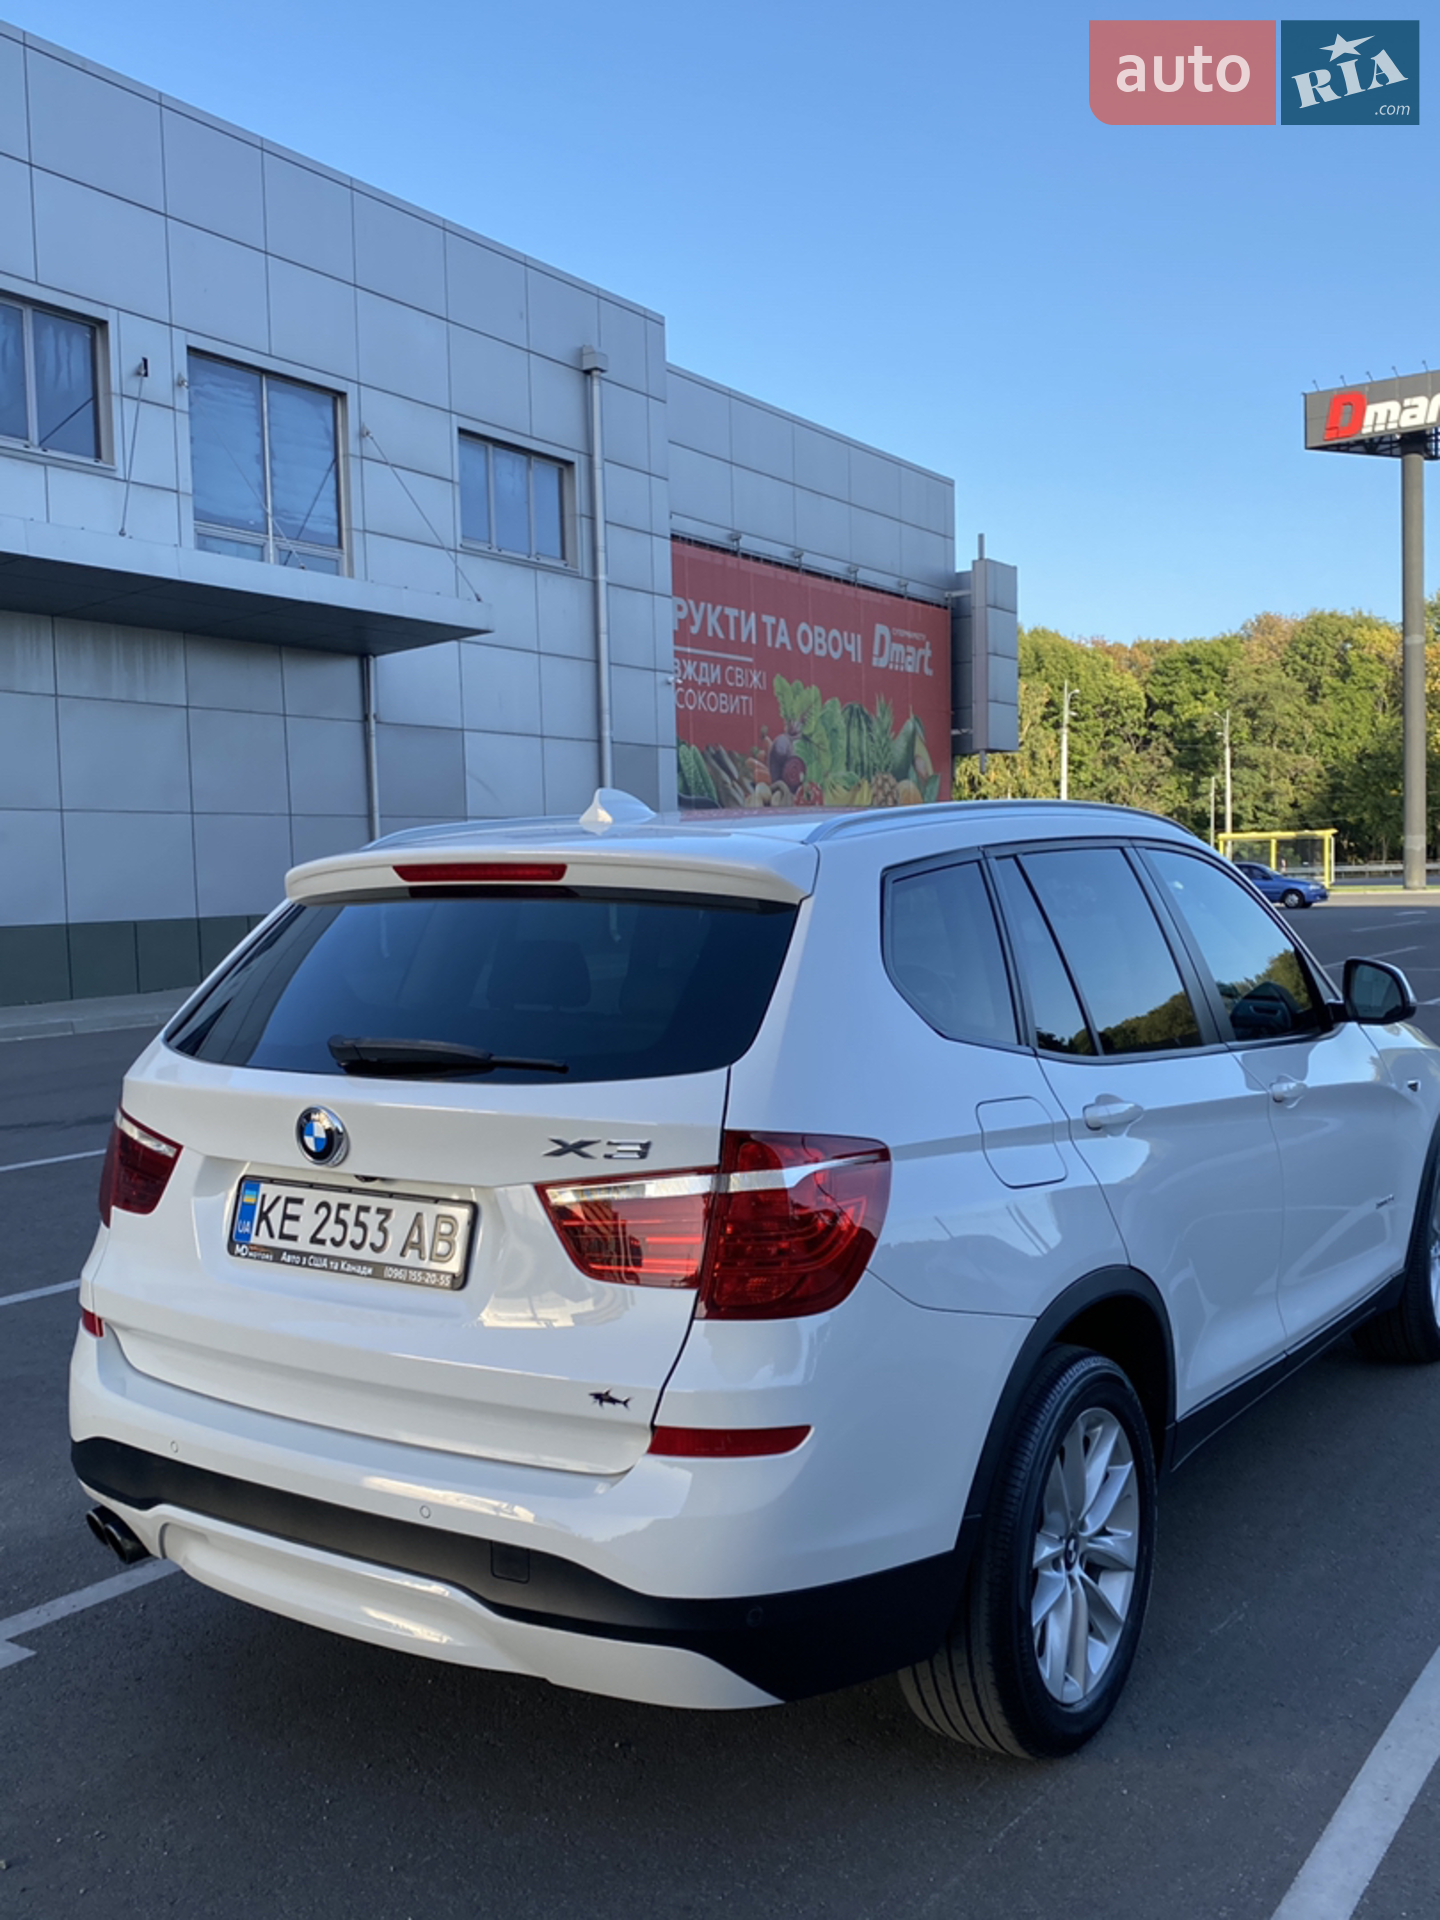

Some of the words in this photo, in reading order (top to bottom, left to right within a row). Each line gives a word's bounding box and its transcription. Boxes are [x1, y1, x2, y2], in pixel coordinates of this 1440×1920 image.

[672, 596, 757, 645] РУКТИ
[761, 613, 793, 652] ТА
[796, 621, 862, 664] ОВОЧІ
[871, 623, 934, 677] Dmart
[725, 665, 767, 691] СВІЖІ
[675, 687, 753, 717] СОКОВИТІ
[541, 1136, 652, 1160] X3
[237, 1219, 251, 1235] UA
[254, 1193, 305, 1243] KE
[309, 1200, 394, 1254] 2553
[399, 1211, 459, 1263] AB
[308, 1255, 328, 1269] США
